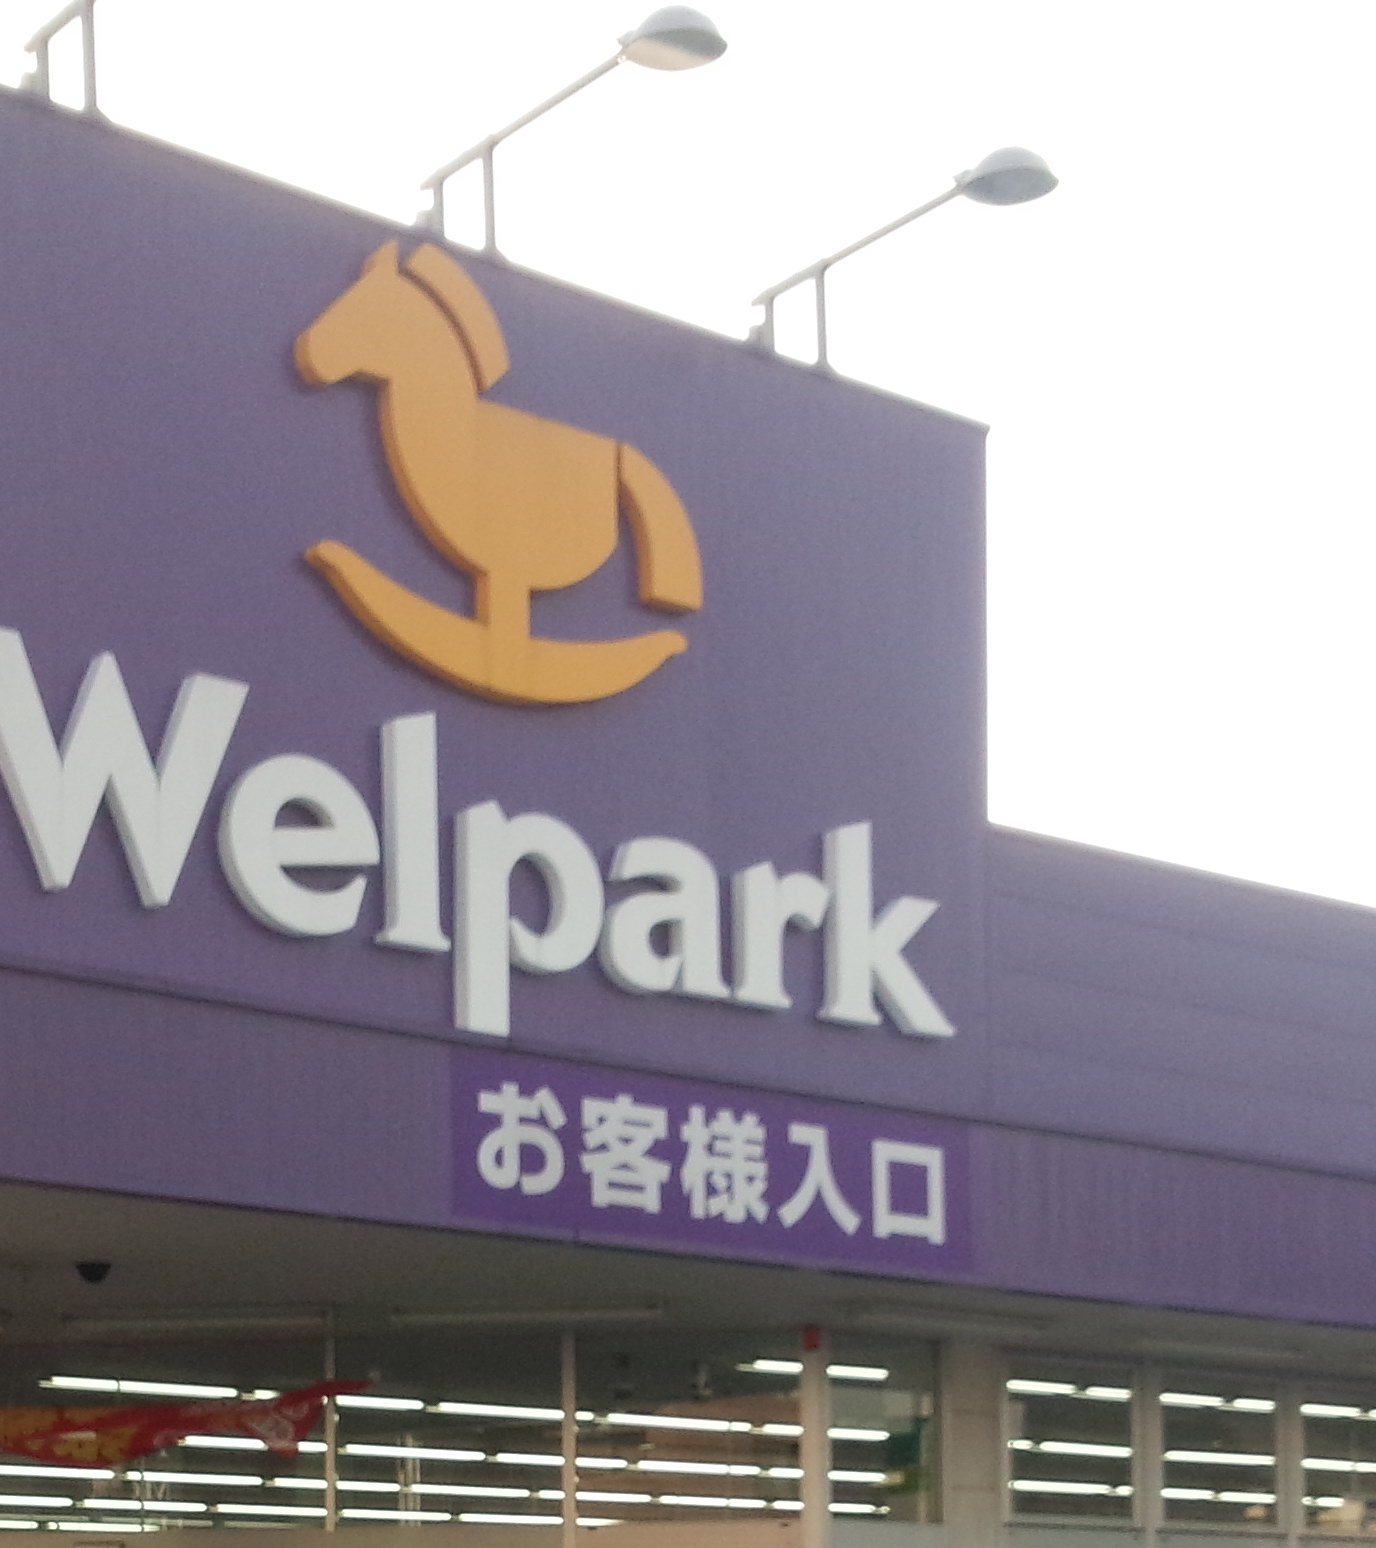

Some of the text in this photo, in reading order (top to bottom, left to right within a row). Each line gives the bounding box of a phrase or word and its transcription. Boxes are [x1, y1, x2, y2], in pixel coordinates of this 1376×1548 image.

[476, 1082, 946, 1245] お客様入口
